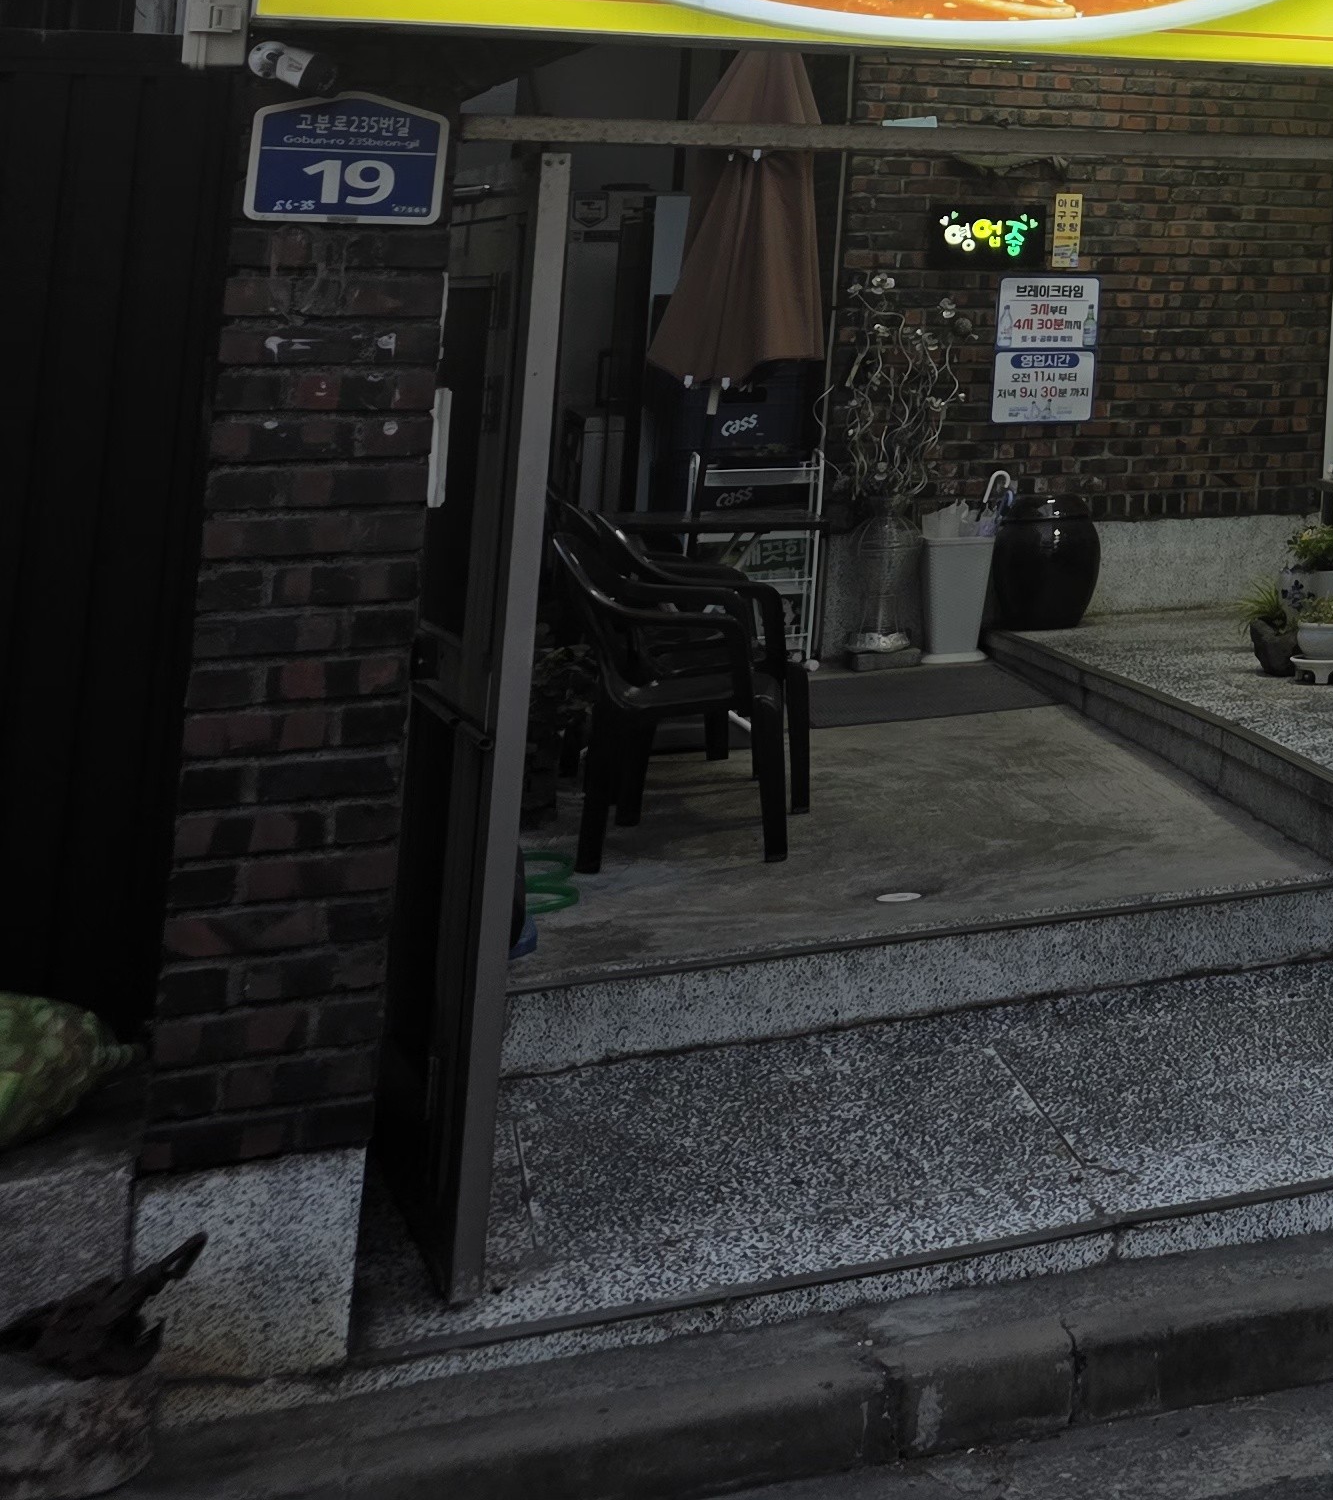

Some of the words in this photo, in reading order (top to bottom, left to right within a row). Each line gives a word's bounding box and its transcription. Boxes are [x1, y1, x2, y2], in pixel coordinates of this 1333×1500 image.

[296, 114, 411, 137] 고분로235번길
[283, 134, 345, 145] Gobun-ro
[348, 136, 420, 149] 235beon-gil
[302, 159, 396, 205] 19
[944, 218, 1028, 256] 영업중
[1016, 285, 1083, 298] 브레이크타임
[1030, 304, 1067, 315] 3시부터
[1013, 318, 1033, 330] 4시
[1037, 318, 1081, 330] 30분까지
[1020, 355, 1070, 367] 영업시간
[1011, 373, 1030, 382] 오전
[1034, 371, 1055, 382] 11시
[1058, 373, 1077, 382] 부터
[997, 389, 1016, 398] 저녁
[1019, 387, 1037, 398] 9시
[1040, 386, 1067, 398] 30분
[1069, 388, 1089, 397] 까지
